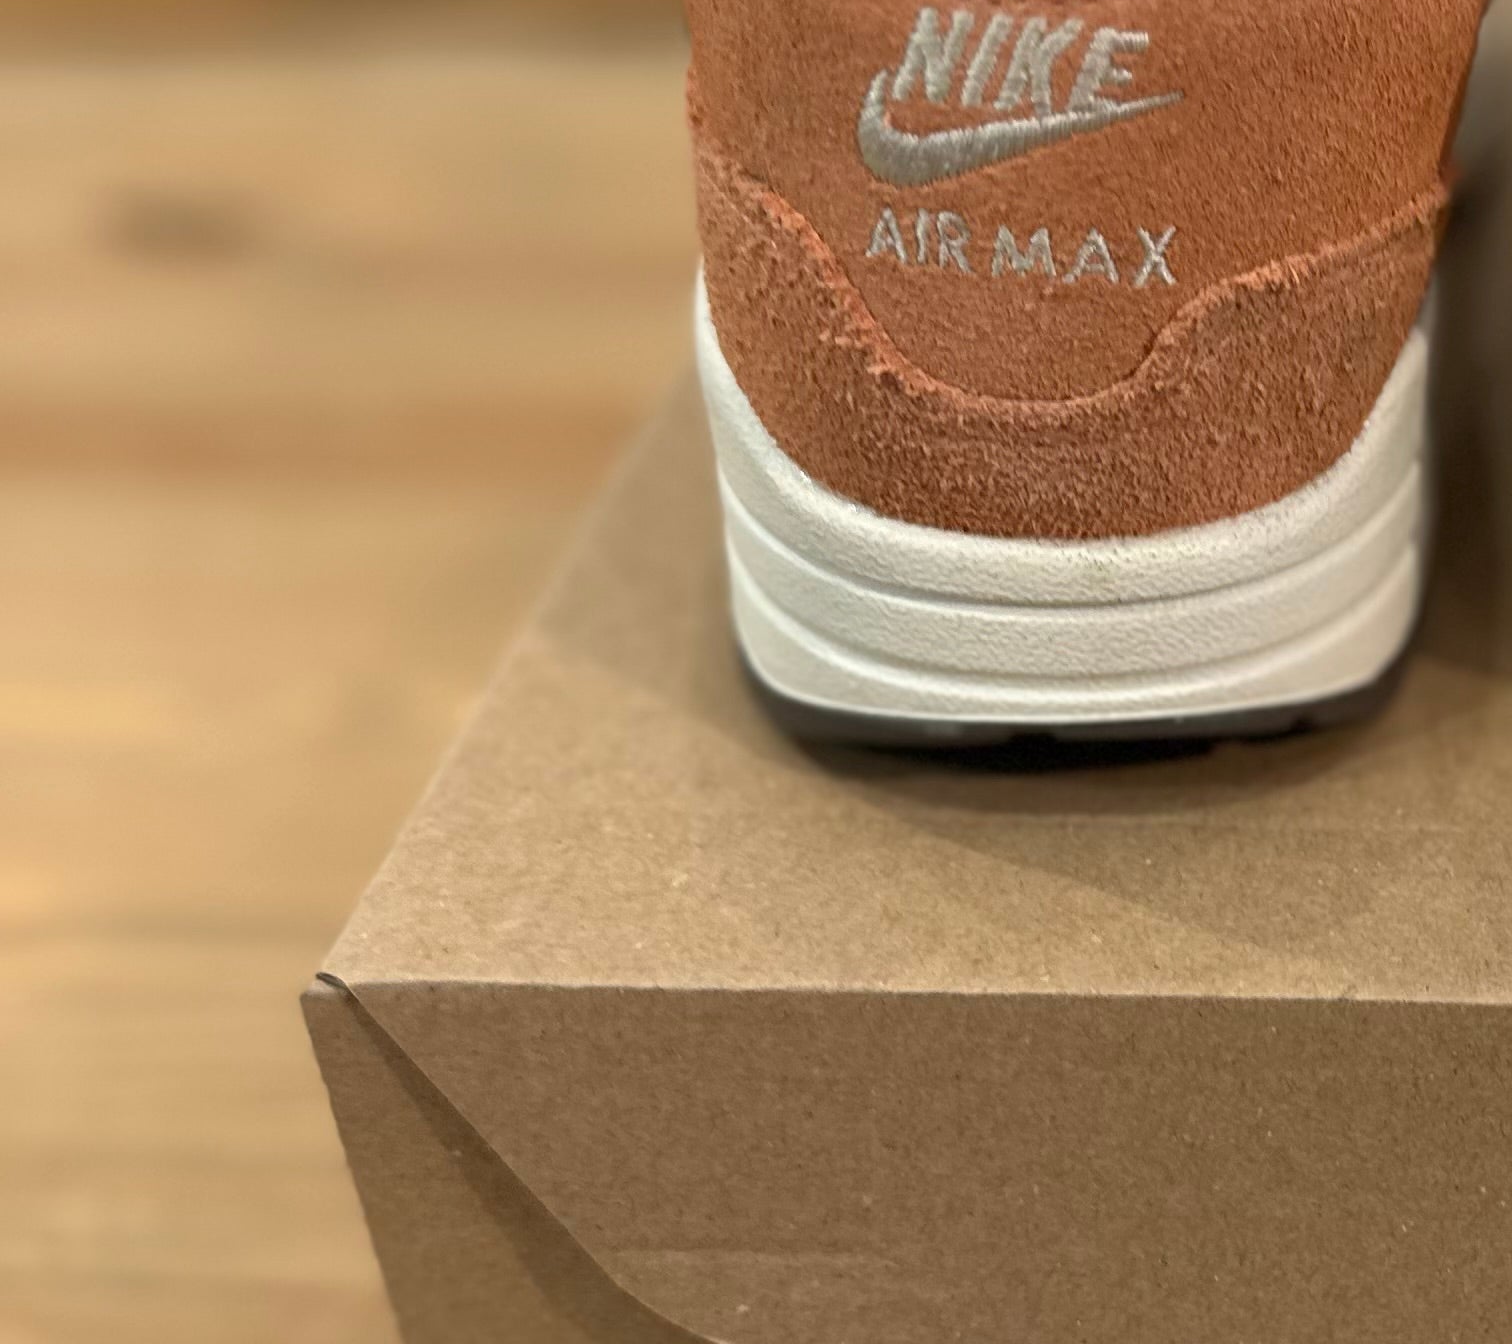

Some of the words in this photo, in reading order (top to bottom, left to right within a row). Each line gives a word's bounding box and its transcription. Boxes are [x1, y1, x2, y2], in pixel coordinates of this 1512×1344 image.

[892, 7, 1149, 118] NIKE
[865, 207, 976, 276] AIR
[991, 222, 1177, 288] MAX
